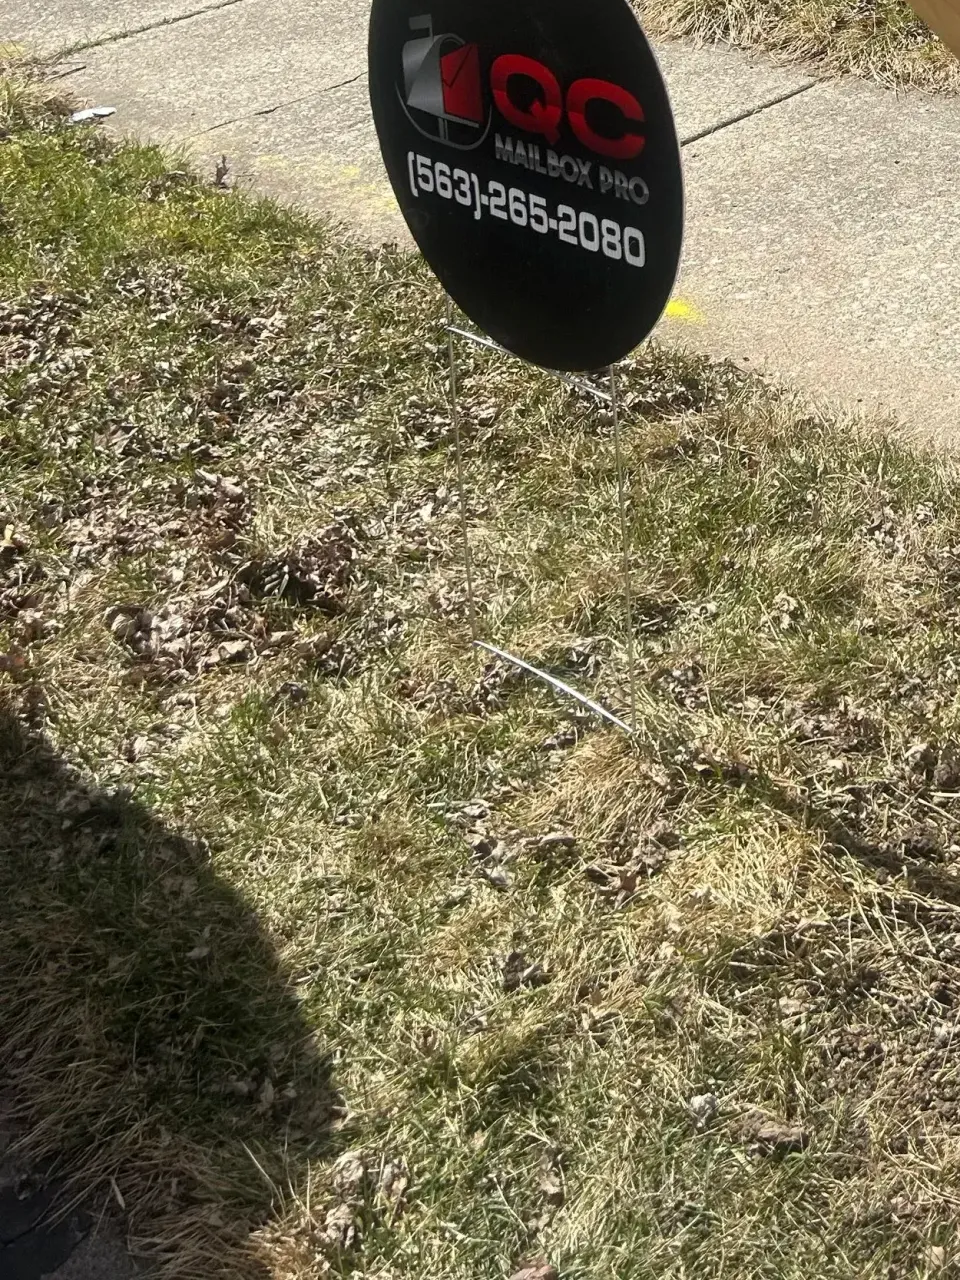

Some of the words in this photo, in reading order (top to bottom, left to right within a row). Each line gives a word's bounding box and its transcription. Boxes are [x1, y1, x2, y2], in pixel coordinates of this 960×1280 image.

[490, 53, 646, 160] QC
[407, 150, 646, 269] (563)-265-2080
[495, 133, 594, 190] MAILBOX
[600, 167, 650, 206] PRO
